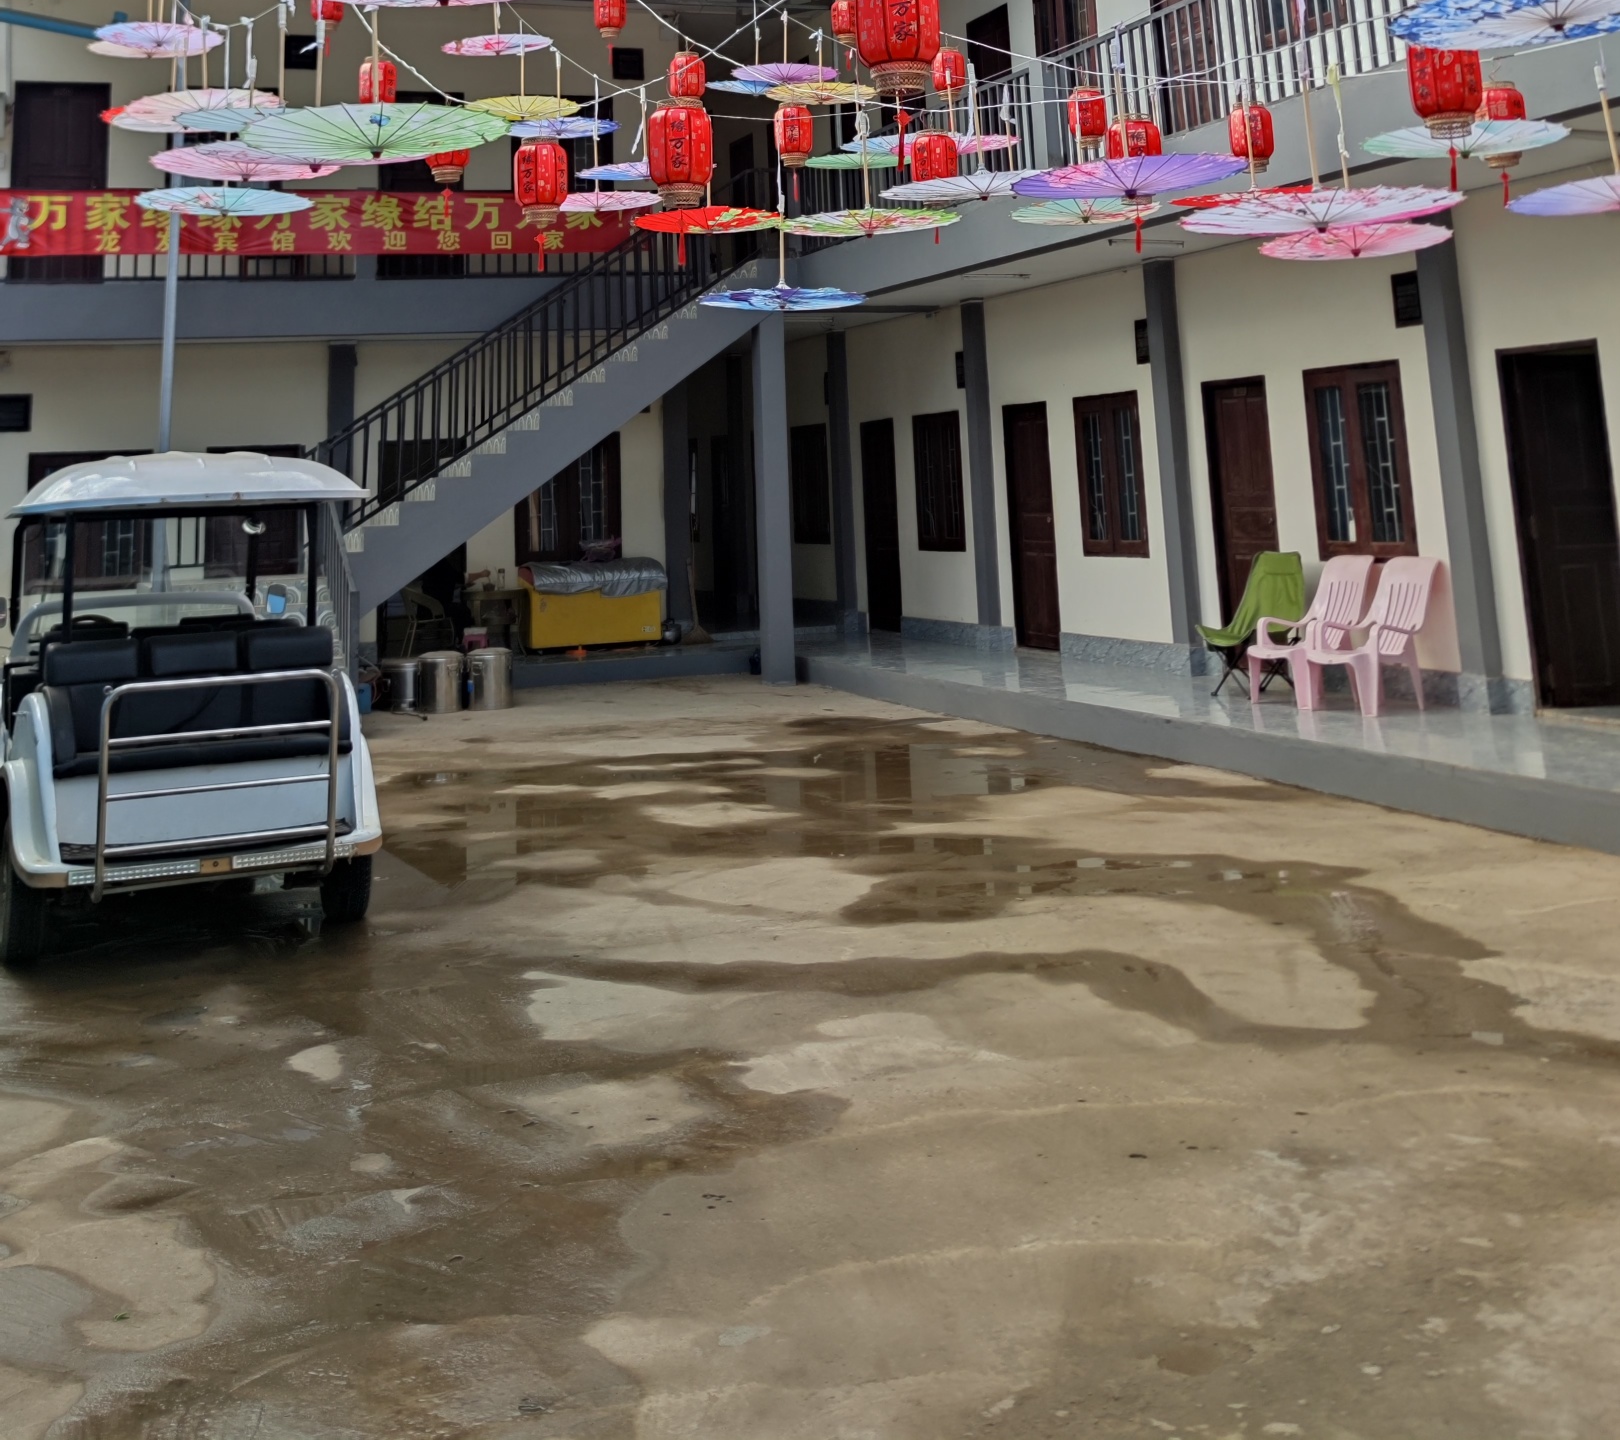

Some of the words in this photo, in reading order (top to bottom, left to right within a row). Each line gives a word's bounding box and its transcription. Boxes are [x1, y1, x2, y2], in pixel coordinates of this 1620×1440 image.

[669, 119, 689, 169] 缘万家
[95, 229, 565, 253] 龙发宾馆欢迎您回家
